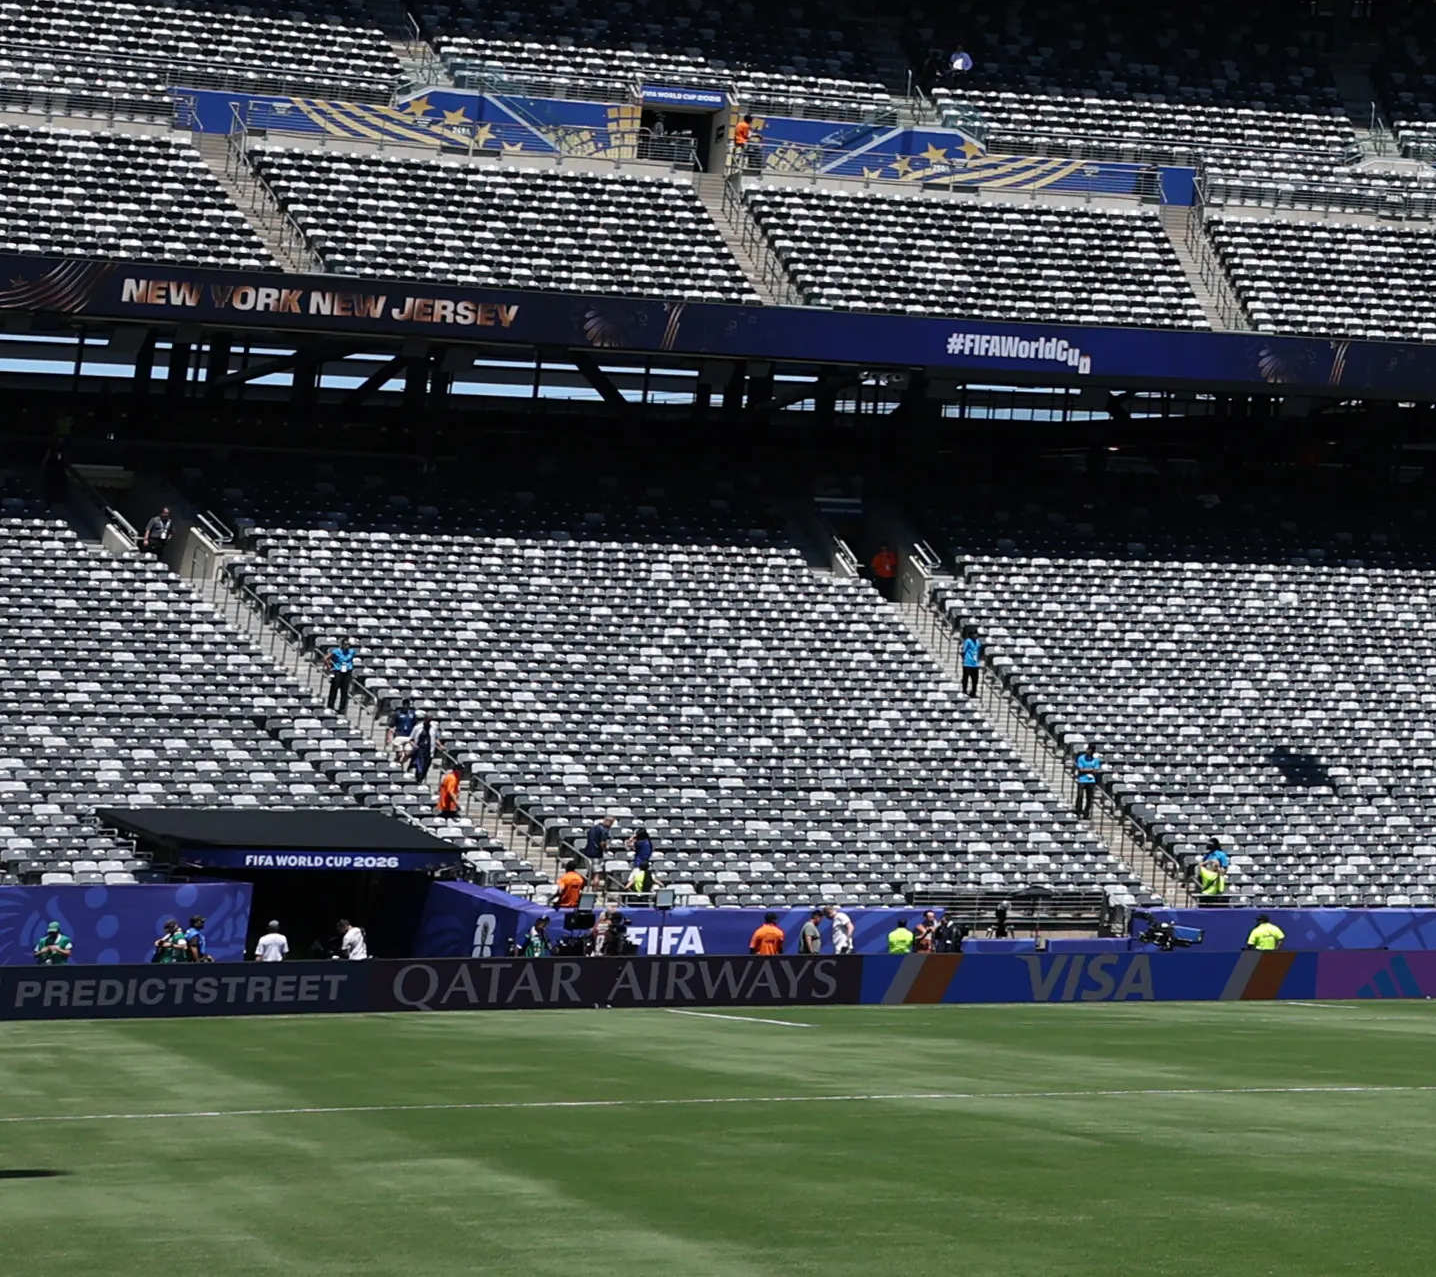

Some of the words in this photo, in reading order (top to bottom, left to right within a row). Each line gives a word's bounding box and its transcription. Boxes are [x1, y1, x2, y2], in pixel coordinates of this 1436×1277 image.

[121, 277, 201, 307] NEW
[209, 282, 302, 314] YORK
[309, 290, 387, 319] NEW
[391, 296, 520, 329] JERSEY
[245, 854, 274, 867] FIFA
[275, 855, 324, 868] WORLD
[325, 856, 352, 868] CUP
[353, 856, 399, 869] 2026
[626, 926, 705, 955] FIFA
[14, 973, 349, 1008] PREDICTSTREET
[392, 961, 583, 1012] QATAR
[606, 957, 838, 1002] AIRWAYS
[1025, 954, 1156, 1002] VISA
